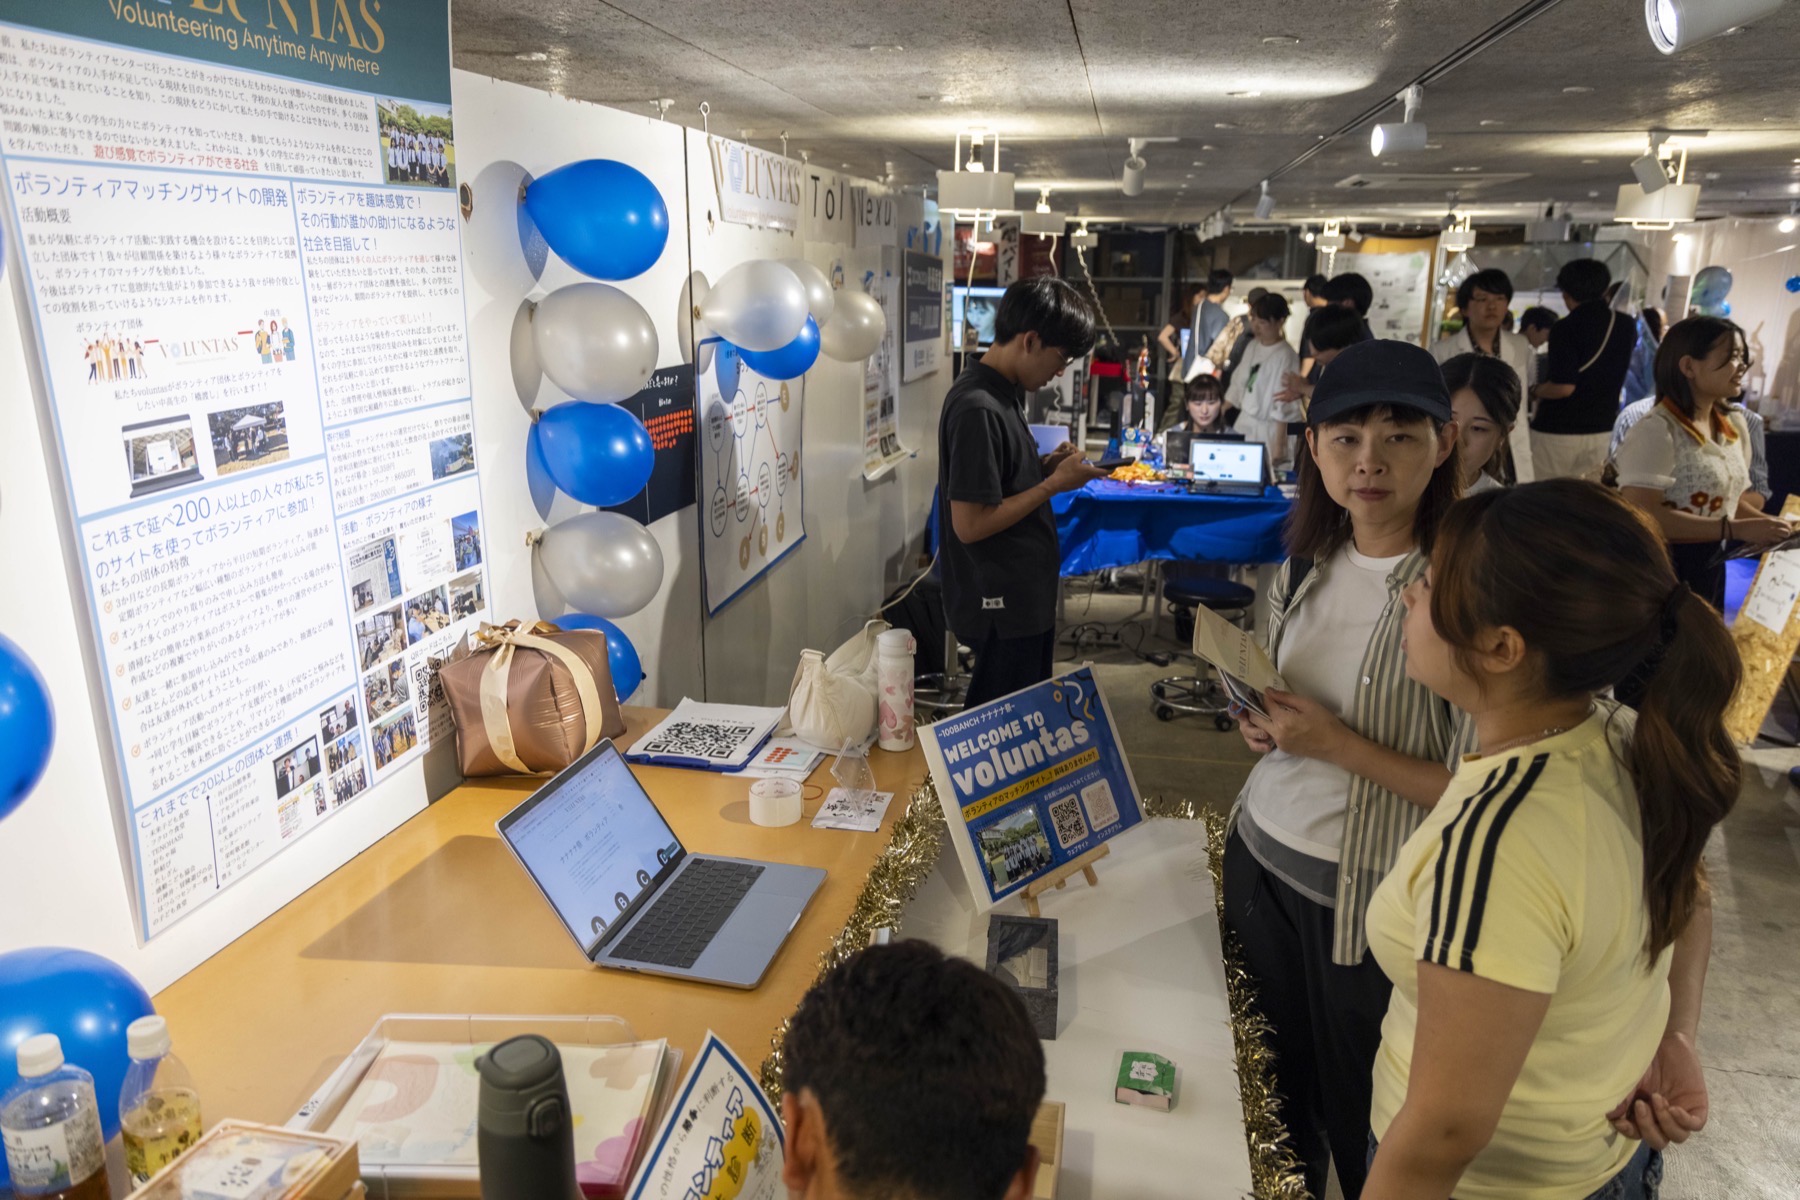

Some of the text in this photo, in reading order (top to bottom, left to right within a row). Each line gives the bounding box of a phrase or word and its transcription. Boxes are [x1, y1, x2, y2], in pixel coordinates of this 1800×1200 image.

[109, 3, 380, 76] Volunteering Anytime Anywhere
[93, 144, 259, 172] 遊び感覚でボランティアができる社会
[13, 172, 289, 207] ボランティアマッチングサイトの開発
[295, 188, 422, 210] ボランティアを趣味感覚で！
[19, 206, 73, 224] 活動概要
[299, 212, 456, 230] その行動が誰かの助けになるような
[302, 236, 378, 252] 社会を目指して！
[75, 318, 144, 333] ボランティア団体
[263, 307, 281, 318] 中高生
[340, 493, 433, 537] 活動・ボランティアの様子
[95, 495, 316, 579] のサイトを使ってボランティアに参加！
[99, 554, 191, 597] 私たちの団体の特徴
[944, 710, 1044, 764] WELCOME TO
[139, 725, 299, 829] これまでで20以上の団体と連携！
[952, 719, 1090, 796] voluntas
[660, 1071, 734, 1200] の性格から勝手に判断する
